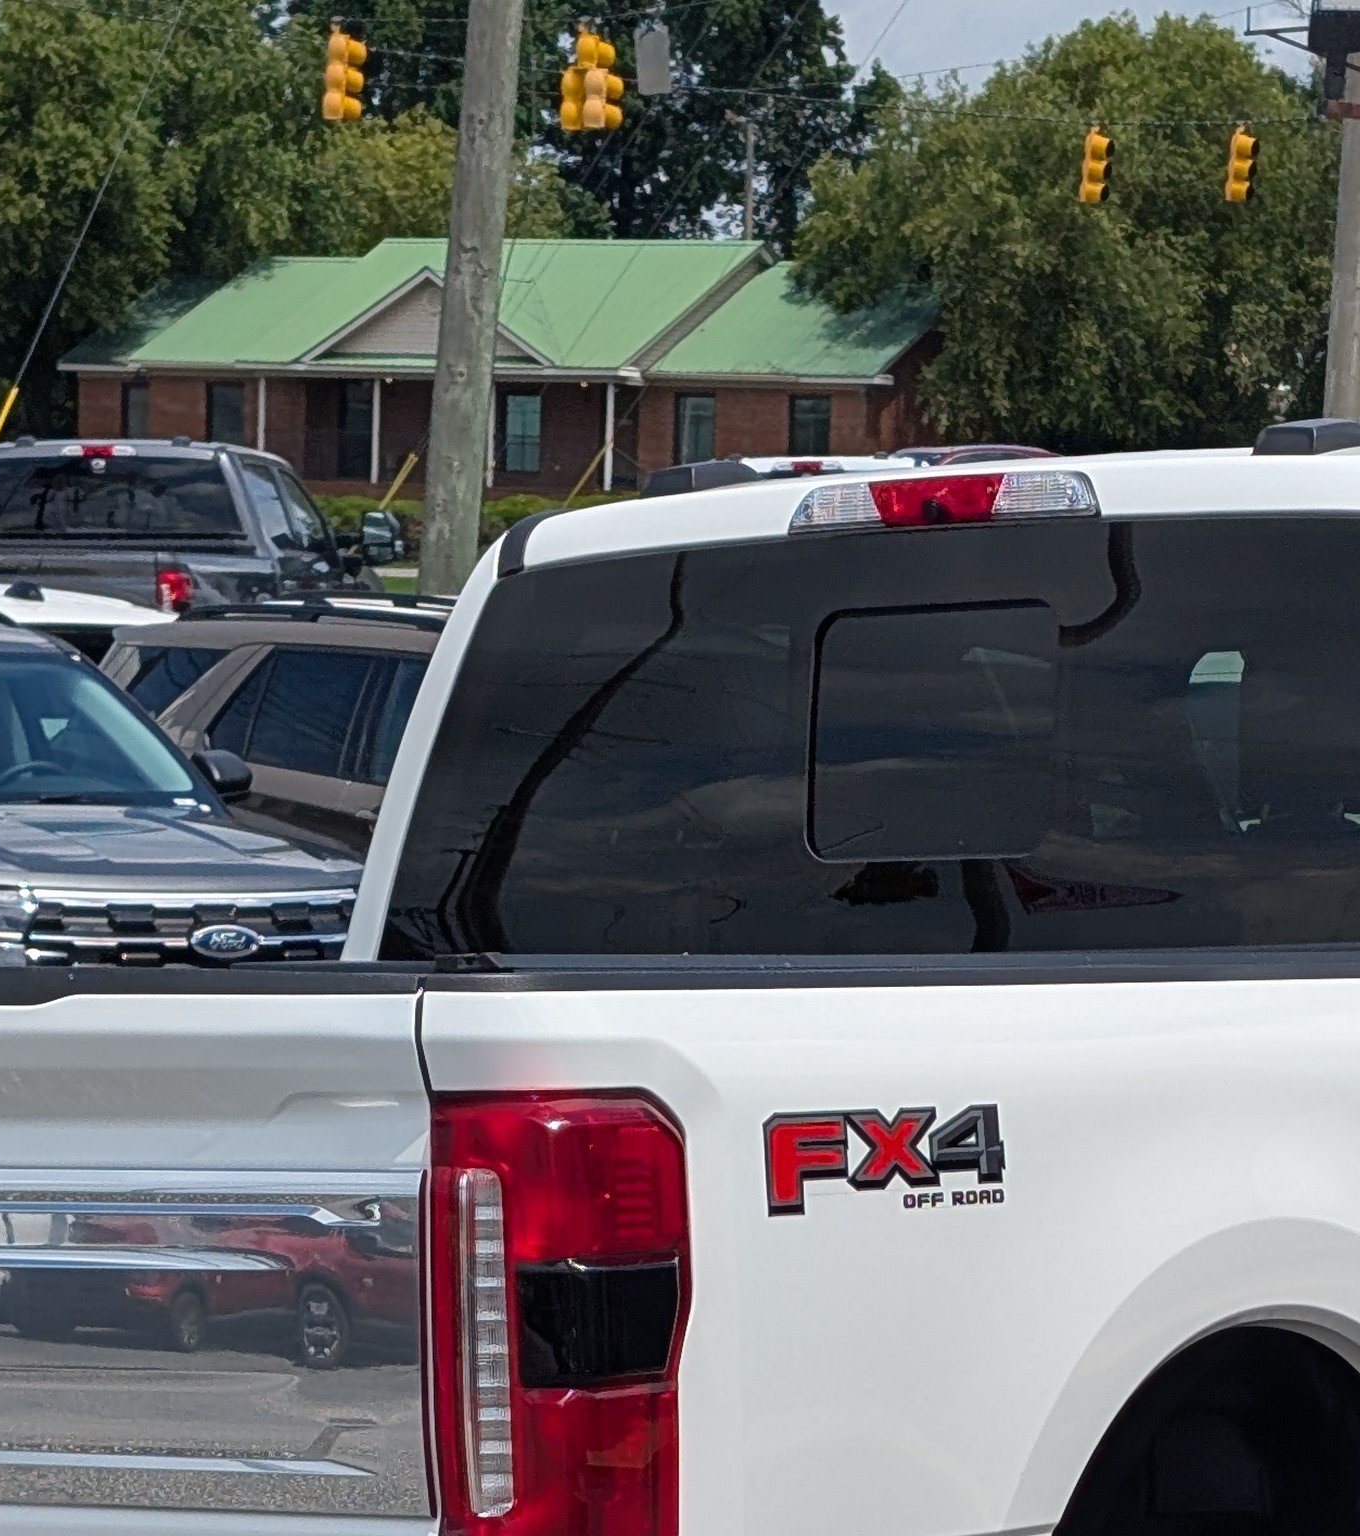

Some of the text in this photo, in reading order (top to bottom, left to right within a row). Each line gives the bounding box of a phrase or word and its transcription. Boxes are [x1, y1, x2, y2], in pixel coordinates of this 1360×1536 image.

[762, 1103, 1006, 1217] FX4
[902, 1188, 1006, 1209] OFF ROAD
